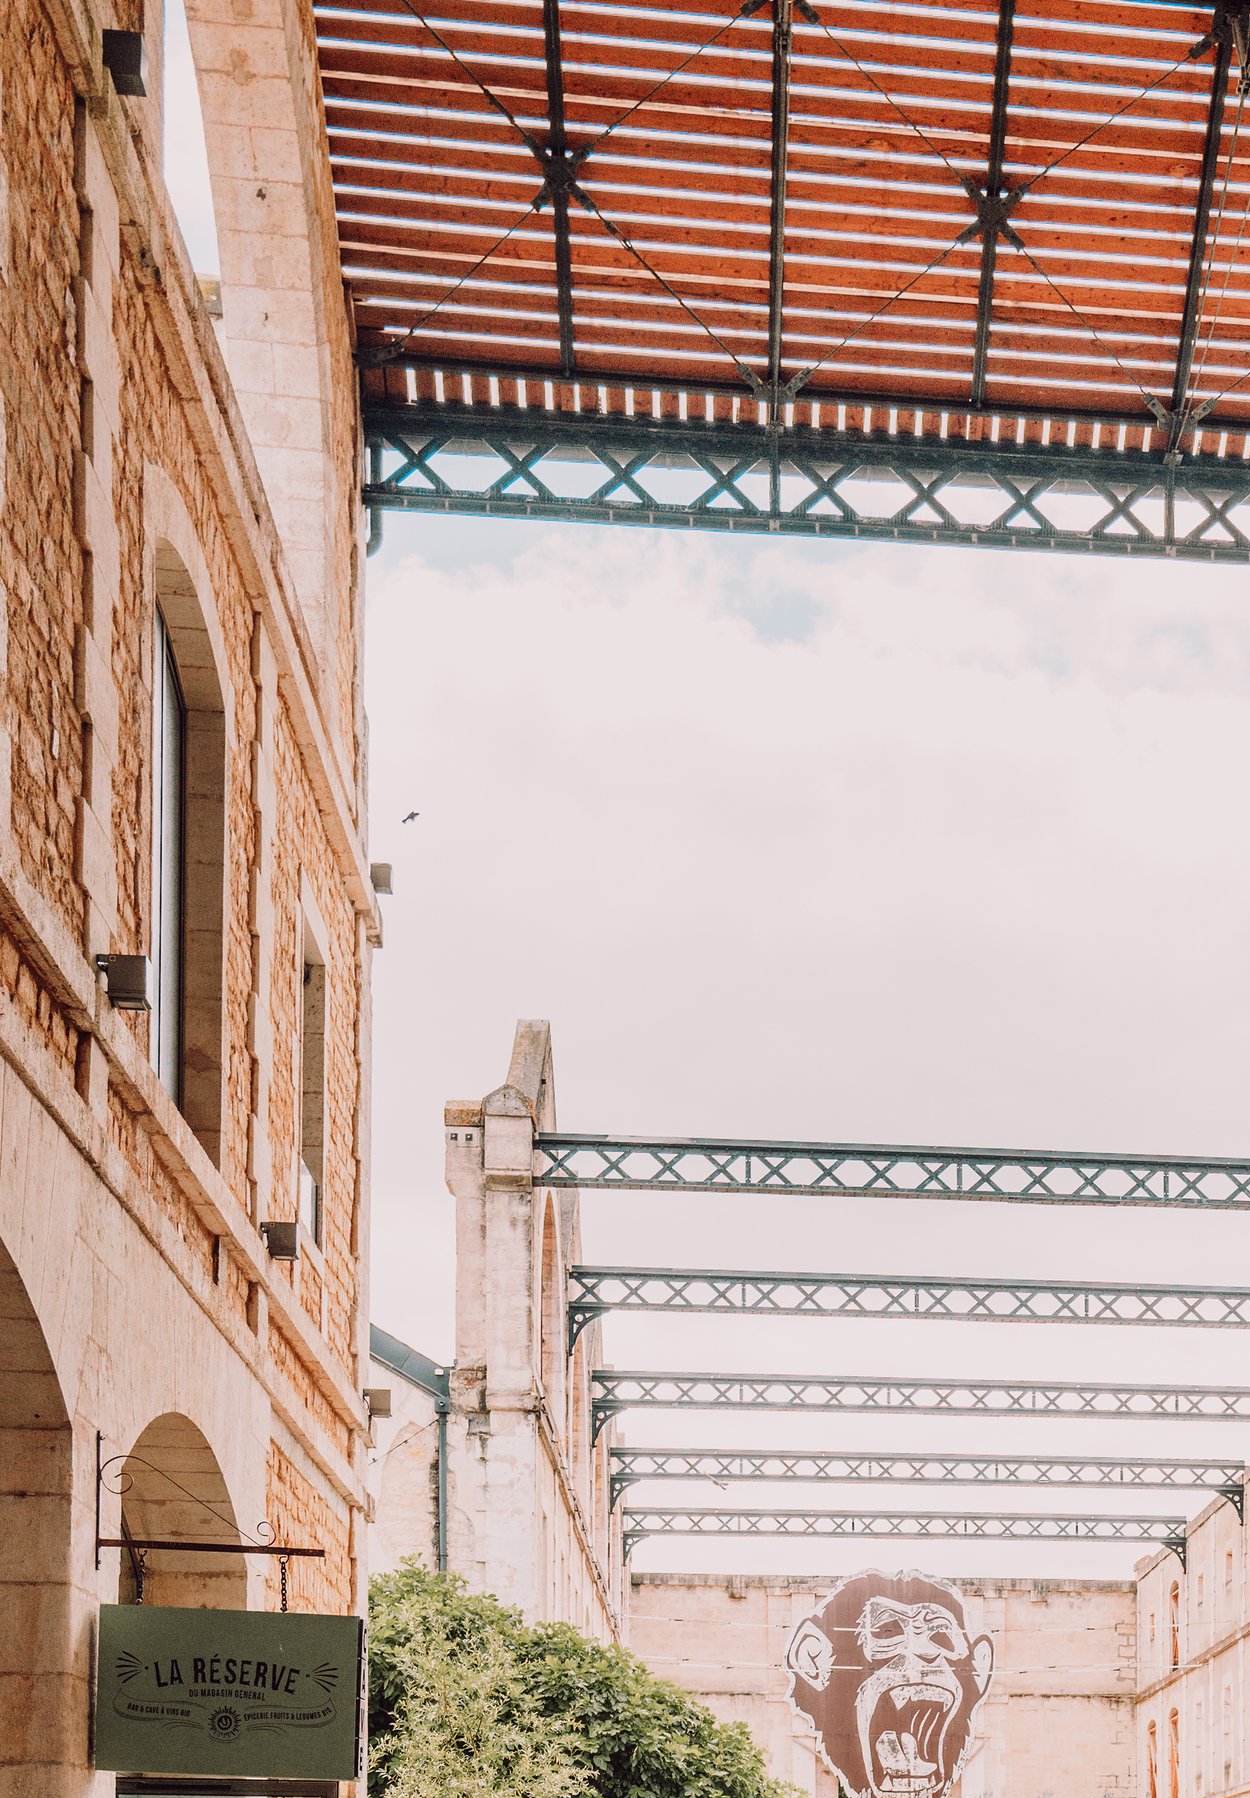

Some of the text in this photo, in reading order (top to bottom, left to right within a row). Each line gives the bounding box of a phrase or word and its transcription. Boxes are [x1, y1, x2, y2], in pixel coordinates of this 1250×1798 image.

[154, 1653, 300, 1695] LA RÉSERVE
[189, 1689, 199, 1698] DU
[200, 1689, 233, 1698] MAGASIN
[127, 1702, 139, 1712] BAR
[145, 1706, 159, 1714] CAVE
[270, 1711, 289, 1720] FRUITS
